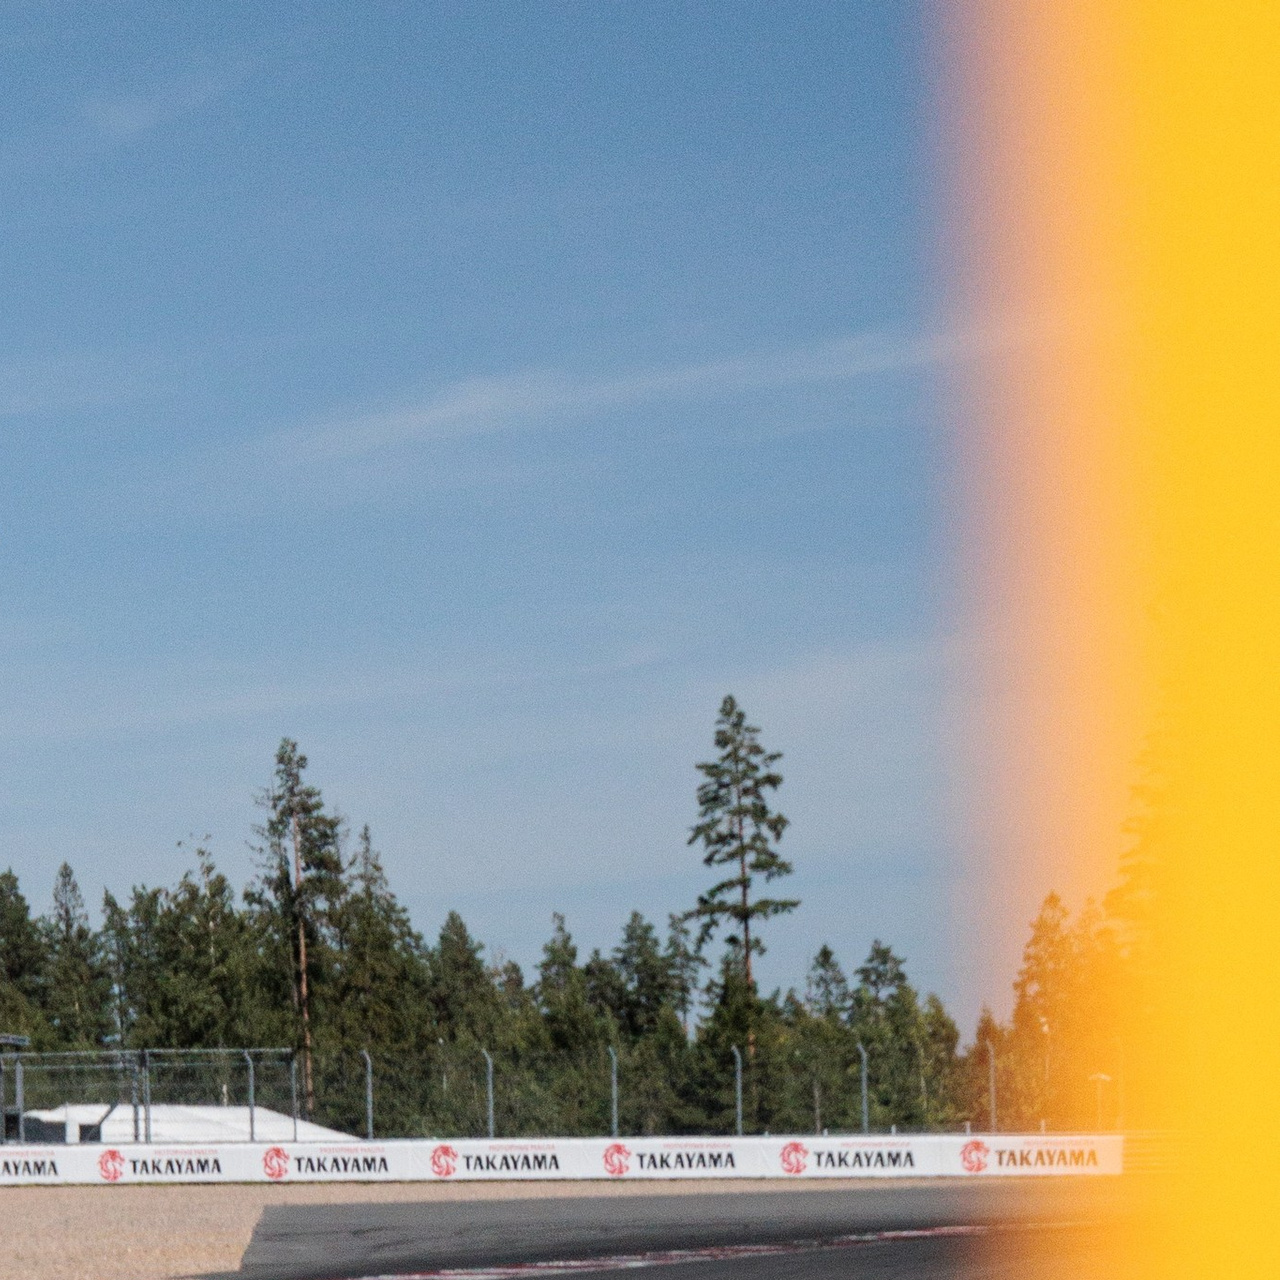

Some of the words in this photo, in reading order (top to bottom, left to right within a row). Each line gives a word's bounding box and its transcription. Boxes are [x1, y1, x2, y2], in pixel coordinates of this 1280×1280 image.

[131, 1157, 222, 1175] TAKAYAMA
[294, 1156, 389, 1173] TAKAYAMA
[462, 1153, 560, 1171] TAKAYAMA
[636, 1152, 736, 1170] TAKAYAMA
[813, 1150, 915, 1168] TAKAYAMA
[995, 1148, 1099, 1167] TAKAYAMA
